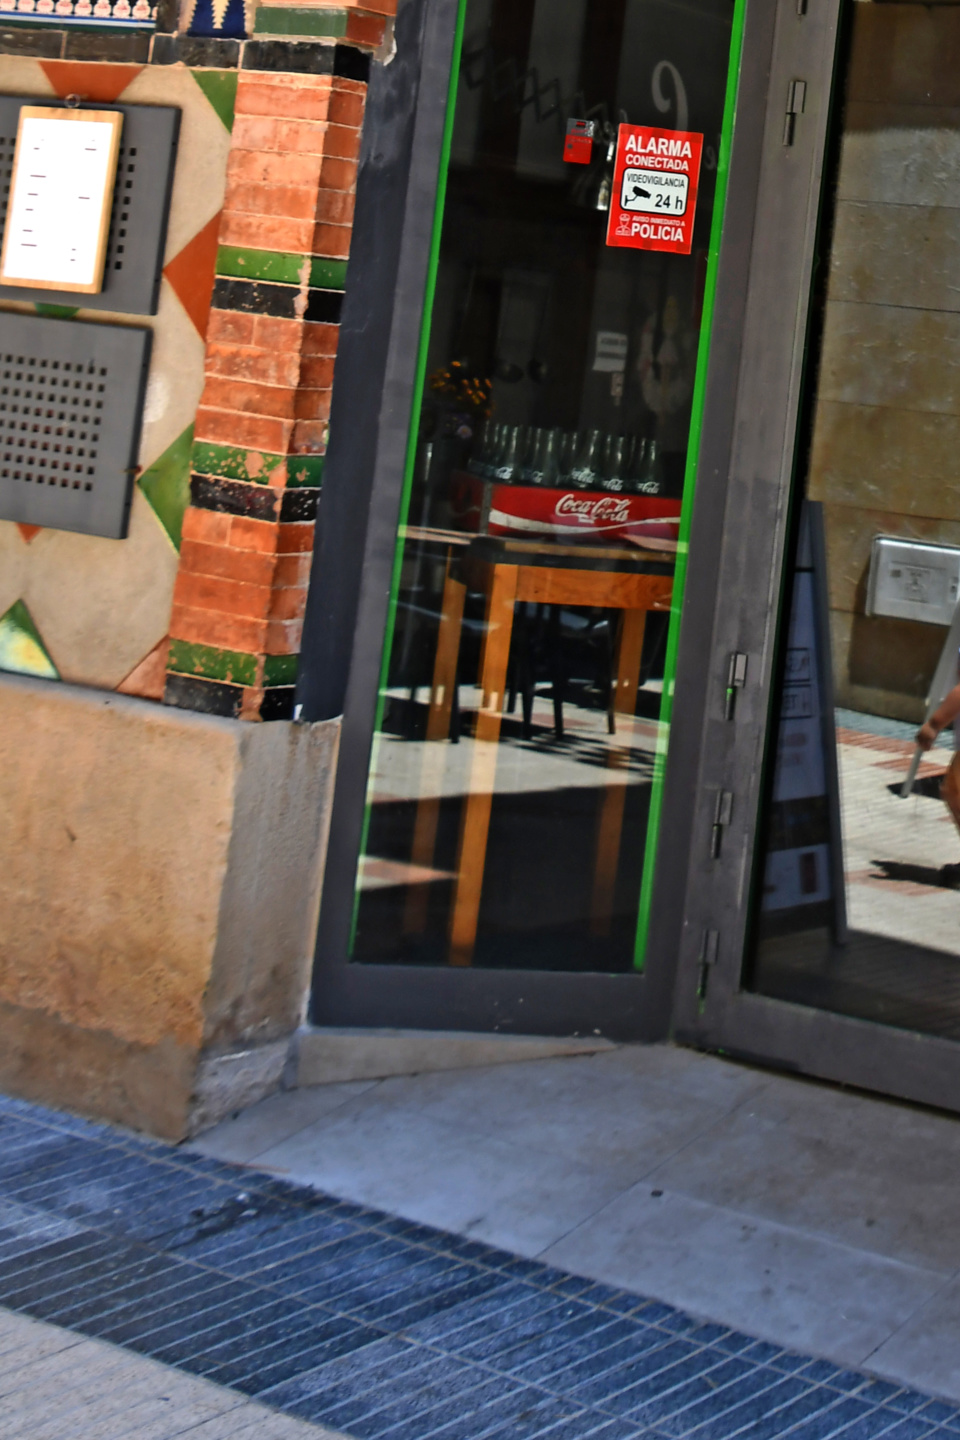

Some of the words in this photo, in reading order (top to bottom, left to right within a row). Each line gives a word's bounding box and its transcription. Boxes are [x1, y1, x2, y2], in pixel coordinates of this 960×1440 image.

[625, 135, 692, 158] ALARMA
[625, 154, 689, 171] CONECTADA
[627, 173, 685, 188] VIDEOVIGILANCIA
[655, 194, 671, 208] 24
[675, 196, 683, 210] h
[631, 223, 684, 242] POLICIA
[555, 494, 631, 523] Coca-Cola
